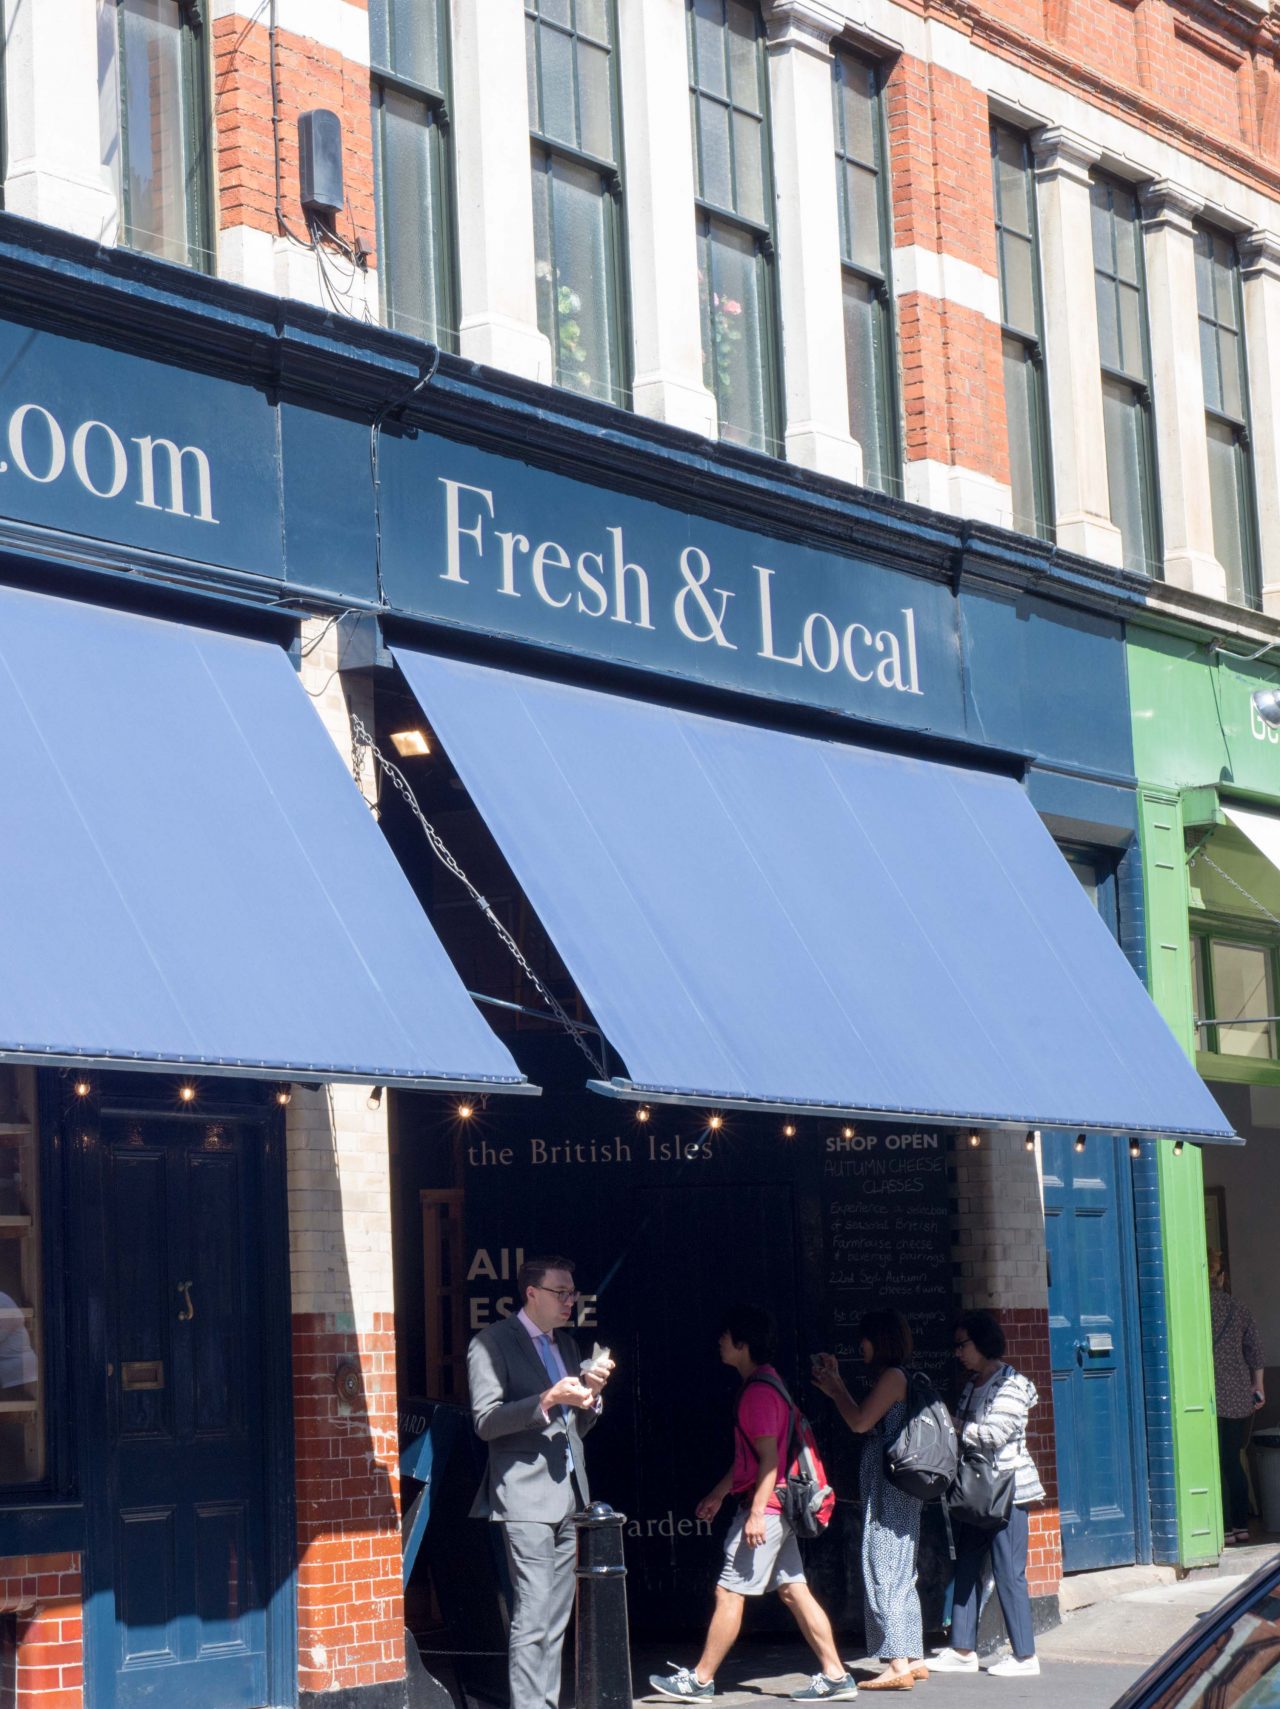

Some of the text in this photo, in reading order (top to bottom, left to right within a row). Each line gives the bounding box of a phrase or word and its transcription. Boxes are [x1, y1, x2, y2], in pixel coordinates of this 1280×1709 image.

[437, 477, 925, 696] Fresh & Local
[468, 1134, 713, 1166] the British Isles
[825, 1133, 938, 1152] SHOP OPEN
[824, 1158, 886, 1177] AUTUMN
[862, 1177, 925, 1194] CLASSES
[627, 1510, 713, 1537] arden
